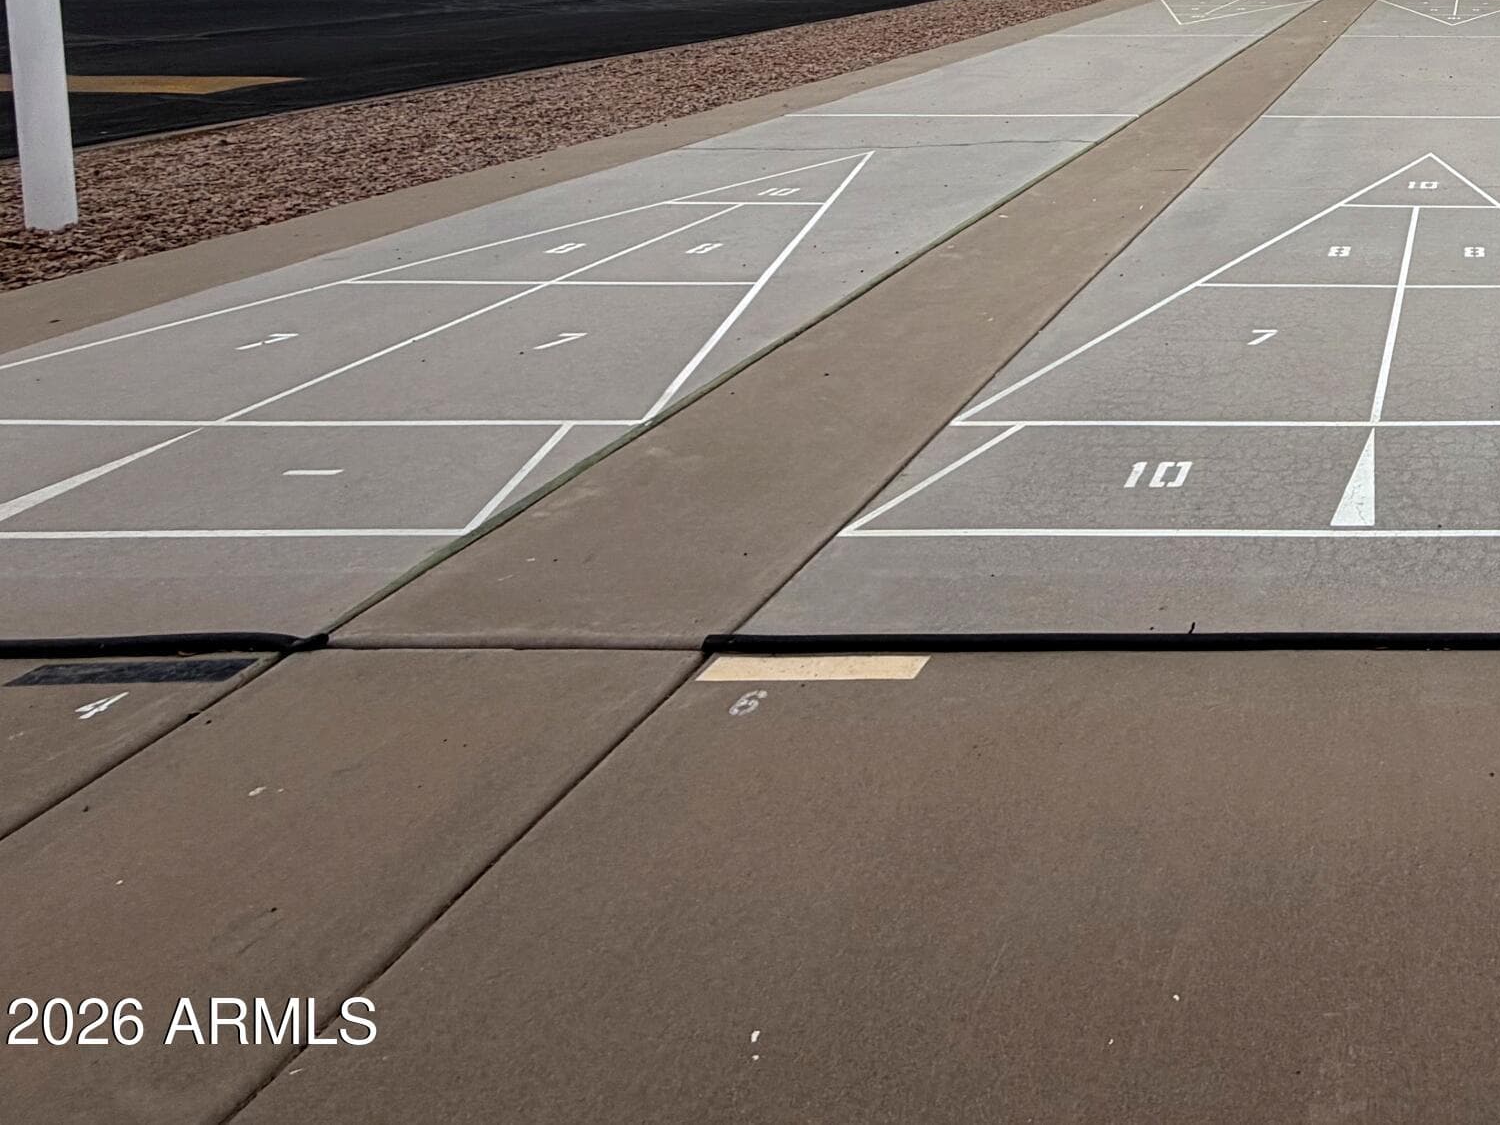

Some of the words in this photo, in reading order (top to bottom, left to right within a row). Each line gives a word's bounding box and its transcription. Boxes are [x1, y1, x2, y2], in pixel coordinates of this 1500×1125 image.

[1408, 181, 1439, 189] 10
[1328, 246, 1351, 257] 8
[1464, 246, 1485, 258] 8
[534, 332, 588, 349] 7
[1247, 329, 1278, 345] 7
[1123, 461, 1193, 488] 10
